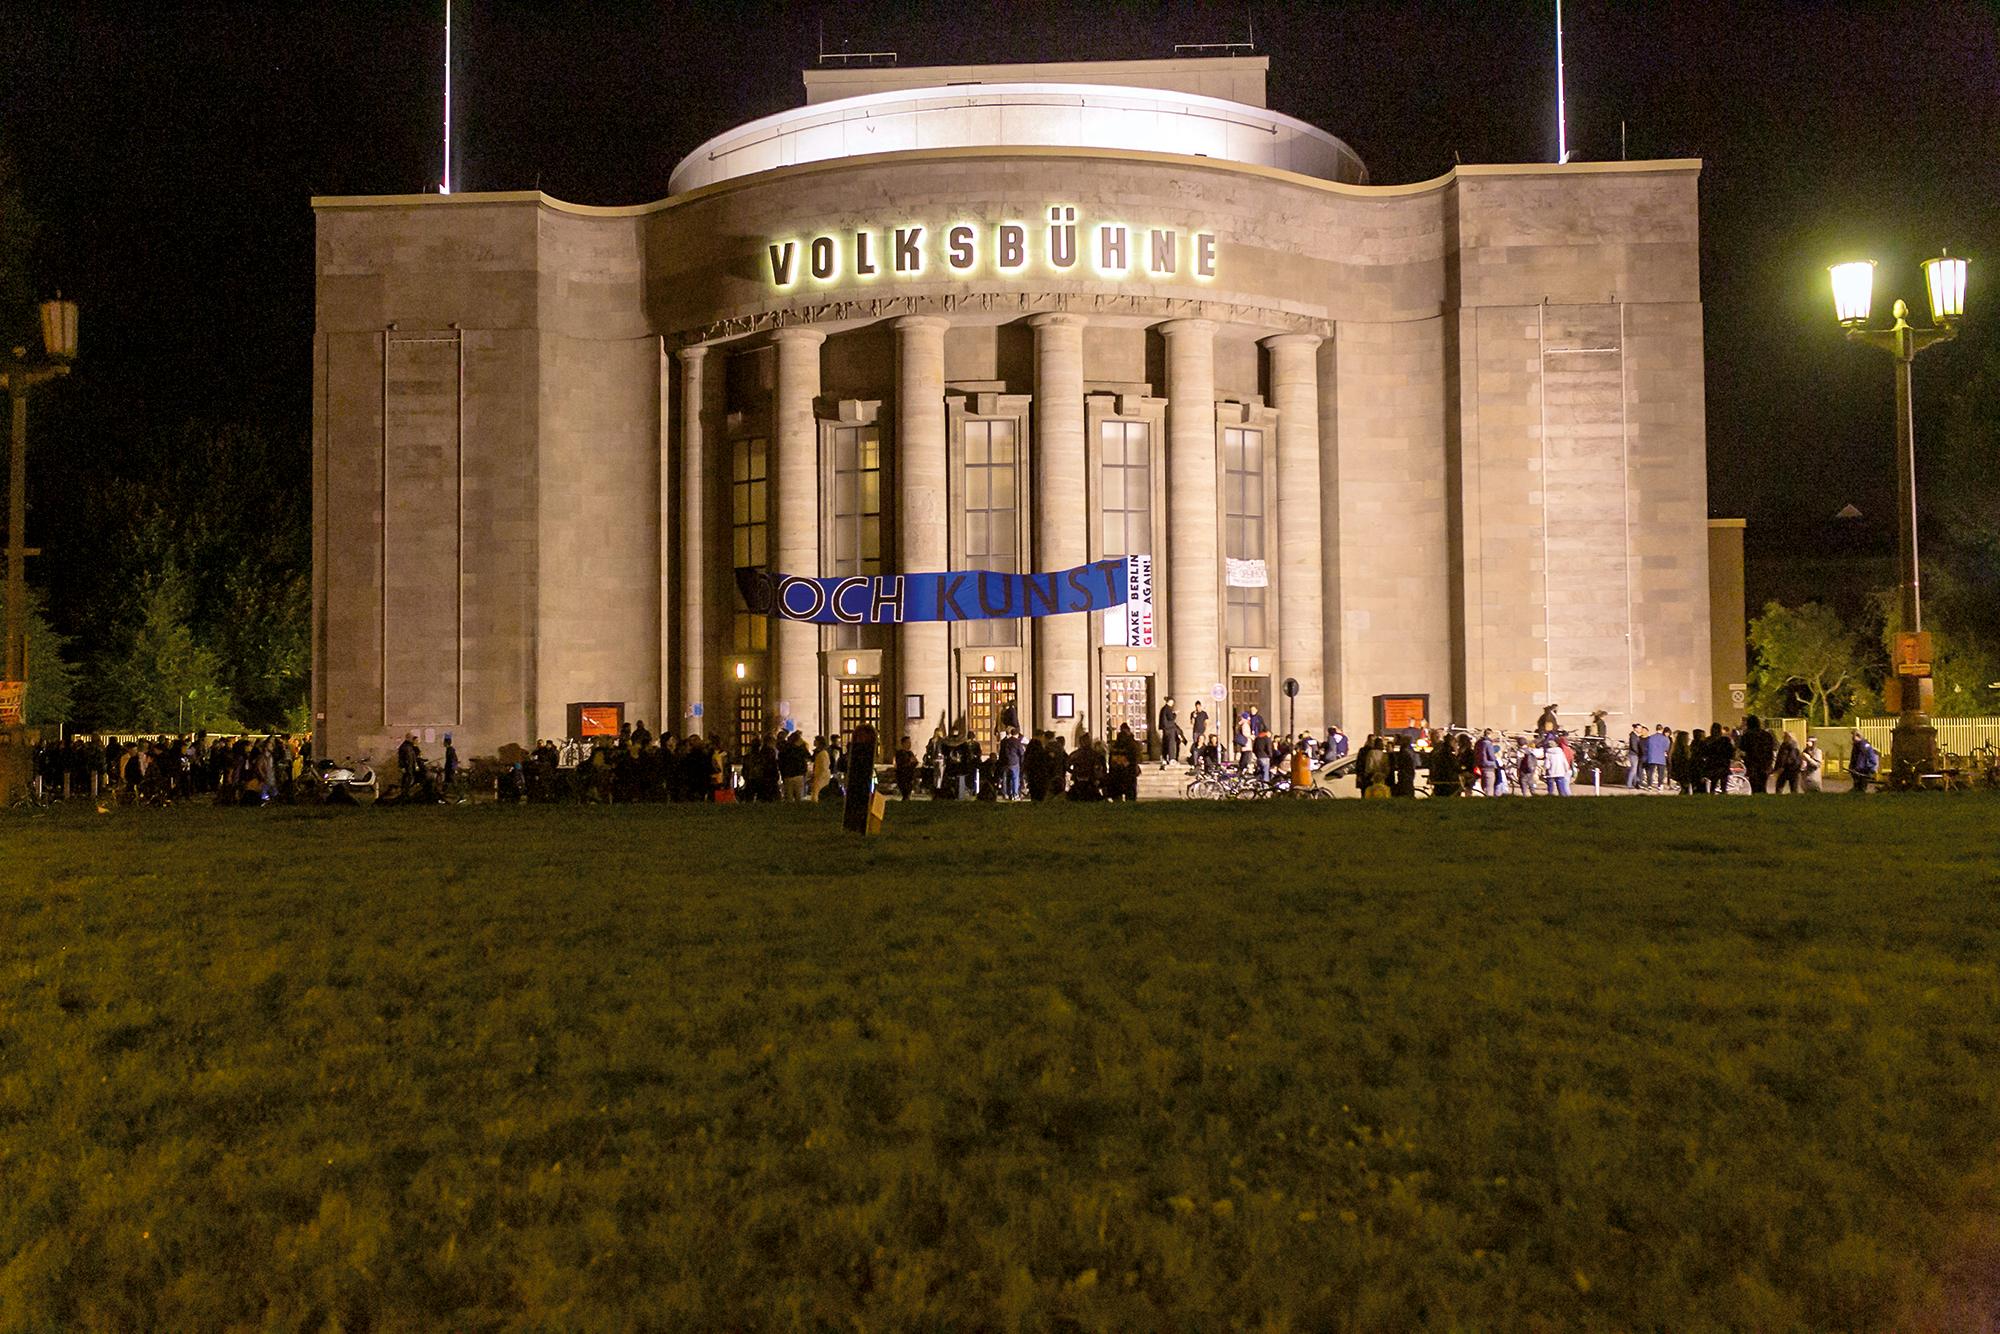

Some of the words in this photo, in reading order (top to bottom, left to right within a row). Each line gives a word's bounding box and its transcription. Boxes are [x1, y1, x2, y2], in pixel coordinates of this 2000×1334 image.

[769, 207, 1216, 286] VOLKSBÜHNE
[936, 562, 1121, 621] KUNST
[1130, 555, 1139, 600] BERLIN
[1143, 560, 1152, 605] AGAIN!
[1131, 610, 1140, 647] MAKE
[1143, 612, 1152, 645] GEIL
